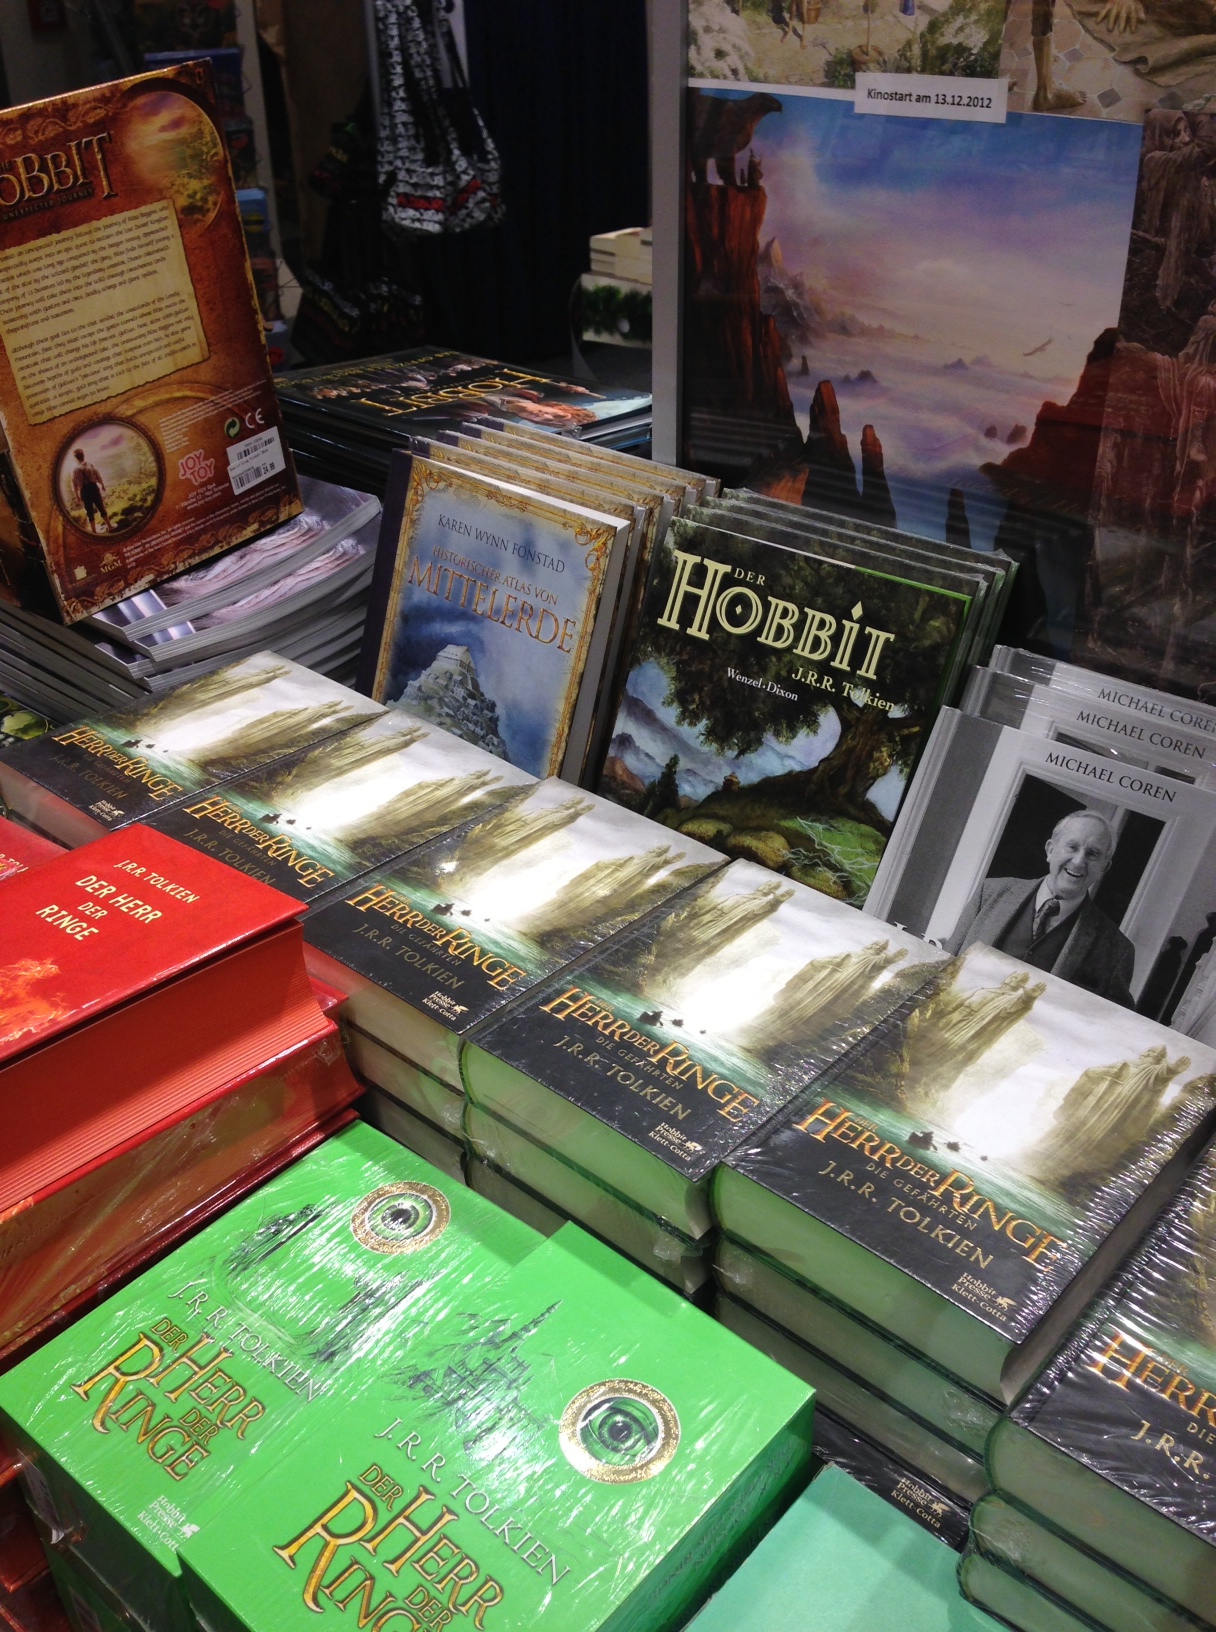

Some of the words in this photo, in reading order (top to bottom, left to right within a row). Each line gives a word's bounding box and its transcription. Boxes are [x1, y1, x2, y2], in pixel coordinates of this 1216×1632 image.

[867, 88, 913, 103] Kinostart
[915, 93, 932, 104] am
[934, 93, 993, 110] 13.12.2012
[0, 132, 118, 205] OBBIT
[180, 450, 204, 477] JOY
[189, 460, 215, 484] TOY
[100, 560, 122, 574] MGM
[438, 514, 471, 538] KAREN
[475, 526, 510, 552] WYNN
[512, 543, 565, 574] FONSTAD
[433, 545, 501, 585] HISTORISCHER
[502, 573, 532, 596] ATLAS
[534, 586, 558, 606] VON
[734, 567, 766, 587] DER
[408, 556, 577, 653] MITTELERDE
[657, 549, 895, 681] HOBBIT
[792, 667, 836, 693] J.R.R.
[842, 681, 896, 713] Tolkien
[1097, 687, 1165, 718] MICHAEL
[1076, 710, 1145, 741] MICHAEL
[1149, 731, 1206, 759] COREN
[79, 768, 128, 800] TOLKIEN
[113, 755, 183, 801] RINGE
[1045, 752, 1116, 784] MICHAEL
[1118, 775, 1177, 803] COREN
[182, 794, 254, 834] HERR
[247, 825, 270, 845] DER
[184, 828, 216, 853] J.R.R.
[218, 849, 277, 887] TOLKIEN
[255, 833, 335, 888] RINGE
[75, 874, 117, 899] DER
[108, 893, 163, 925] HERR
[113, 859, 142, 877] J.R.R.
[143, 872, 200, 904] TOLKIEN
[35, 904, 100, 941] RINGE
[77, 902, 108, 920] DER
[390, 923, 407, 936] DIE
[345, 882, 423, 929] HERR
[416, 919, 447, 940] DER
[433, 926, 527, 991] RINGE
[353, 923, 391, 950] J.R.R.
[395, 945, 465, 990] TOLKIEN
[538, 985, 632, 1042] HERR
[623, 1030, 662, 1056] DER
[649, 1040, 761, 1123] RINGE
[596, 1036, 615, 1051] DIE
[618, 1049, 684, 1091] GEFÄHRTEN
[553, 1035, 602, 1071] J.R.R.
[606, 1063, 693, 1121] TOLKIEN
[649, 1131, 692, 1161] Klett-Cotta
[655, 1125, 682, 1144] Presse
[660, 1122, 687, 1141] Hobbit
[792, 1098, 904, 1169] HERR
[897, 1152, 941, 1188] DER
[928, 1168, 1069, 1273] RINGE
[866, 1162, 889, 1180] DIE
[893, 1178, 978, 1231] GEFÄHRTEN
[817, 1160, 878, 1203] J.R.R.
[887, 1196, 995, 1269] TOLKIEN
[951, 1283, 1008, 1322] Klett-Cotta
[957, 1276, 992, 1301] Presse
[962, 1271, 998, 1296] Hobbit
[150, 1317, 189, 1353] DER
[228, 1321, 325, 1403] TOLKIEN
[1084, 1326, 1216, 1427] HERR
[70, 1331, 210, 1481] RINGE
[146, 1332, 266, 1440] HERR
[178, 1408, 219, 1446] DER
[1131, 1420, 1210, 1480] J.R.R.
[1186, 1422, 1216, 1446] DIE
[358, 1462, 405, 1511] DER
[890, 1490, 941, 1528] Klett-Cotta
[896, 1482, 927, 1506] Presse
[137, 1510, 179, 1553] Klett-Cott
[149, 1500, 177, 1529] Presse
[157, 1495, 187, 1525] Hobbit
[449, 1473, 571, 1585] TOLKIEN
[272, 1480, 420, 1632] RING
[358, 1484, 504, 1631] HERR
[403, 1584, 452, 1632] DER
